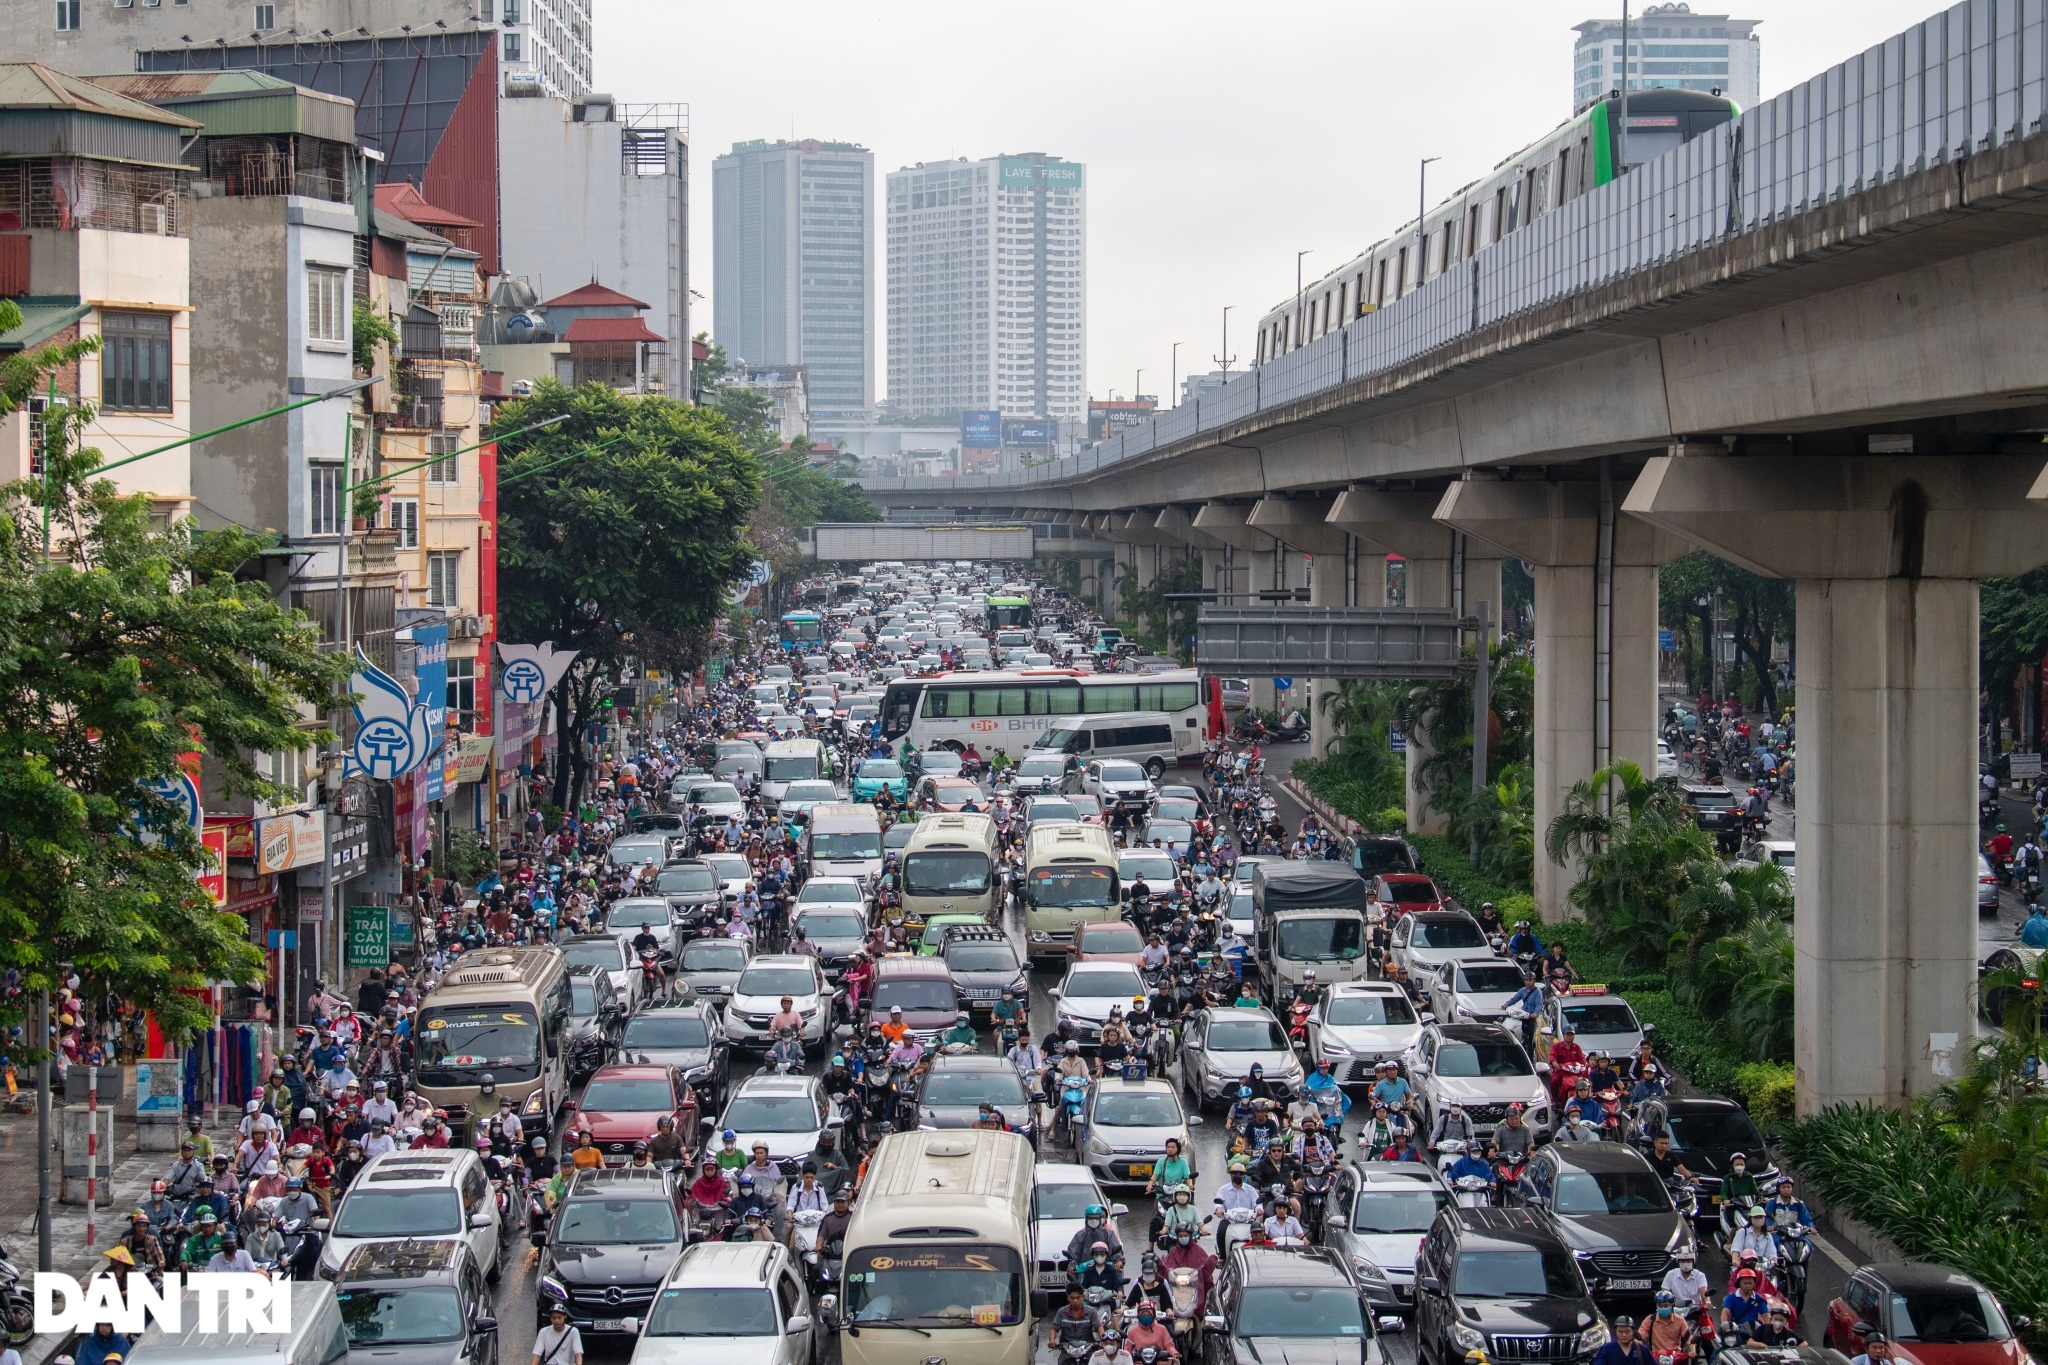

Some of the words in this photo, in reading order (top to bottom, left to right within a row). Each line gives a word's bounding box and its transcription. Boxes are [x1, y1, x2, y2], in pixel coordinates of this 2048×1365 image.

[1005, 168, 1031, 178] LAYE
[1041, 169, 1076, 179] FRESH
[266, 845, 277, 862] BIA
[276, 837, 288, 856] VIỆT
[307, 898, 323, 906] GÓP
[354, 918, 384, 930] TRÁI
[354, 930, 384, 943] CÂY
[353, 944, 384, 956] TƯƠI
[350, 957, 368, 965] NHẬP
[445, 1021, 480, 1029] HYUNDAI
[896, 1259, 938, 1267] HYUNDAI
[979, 1312, 996, 1323] 09
